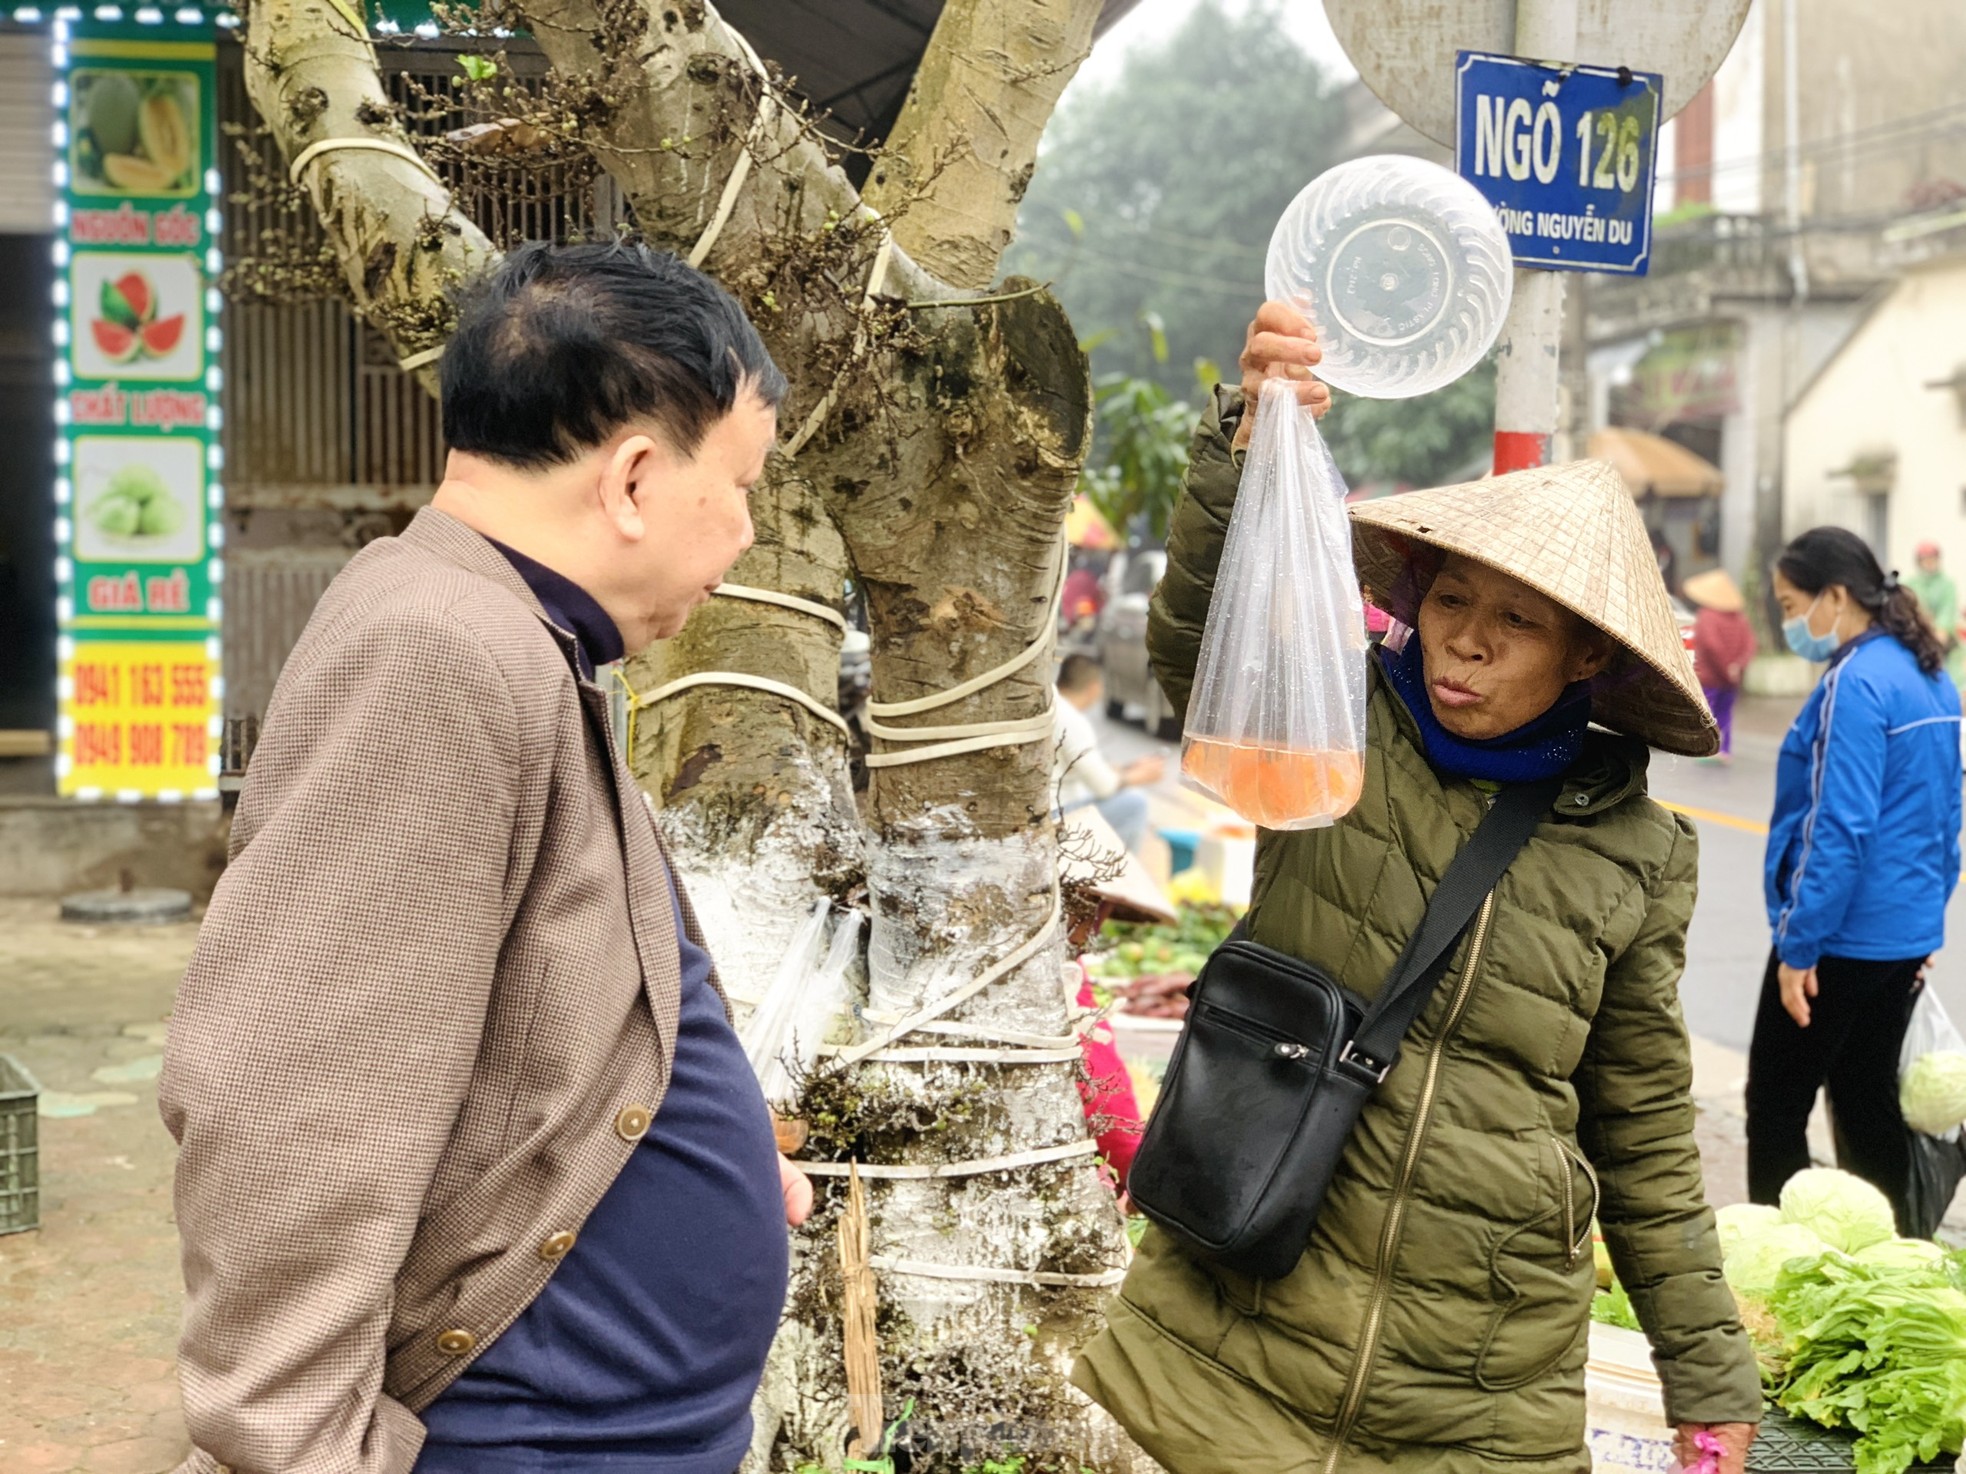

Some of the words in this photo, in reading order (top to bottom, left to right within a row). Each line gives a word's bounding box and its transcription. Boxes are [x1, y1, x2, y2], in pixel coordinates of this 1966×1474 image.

[1475, 80, 1562, 184] NGÕ
[1576, 111, 1640, 193] 126
[1495, 201, 1533, 236] ỜNG
[1537, 204, 1605, 242] NGUYỄN
[1608, 219, 1633, 245] DU
[88, 570, 143, 611] GIÁ
[76, 663, 120, 706] 0941
[172, 663, 206, 706] 555
[76, 723, 121, 766] 0949
